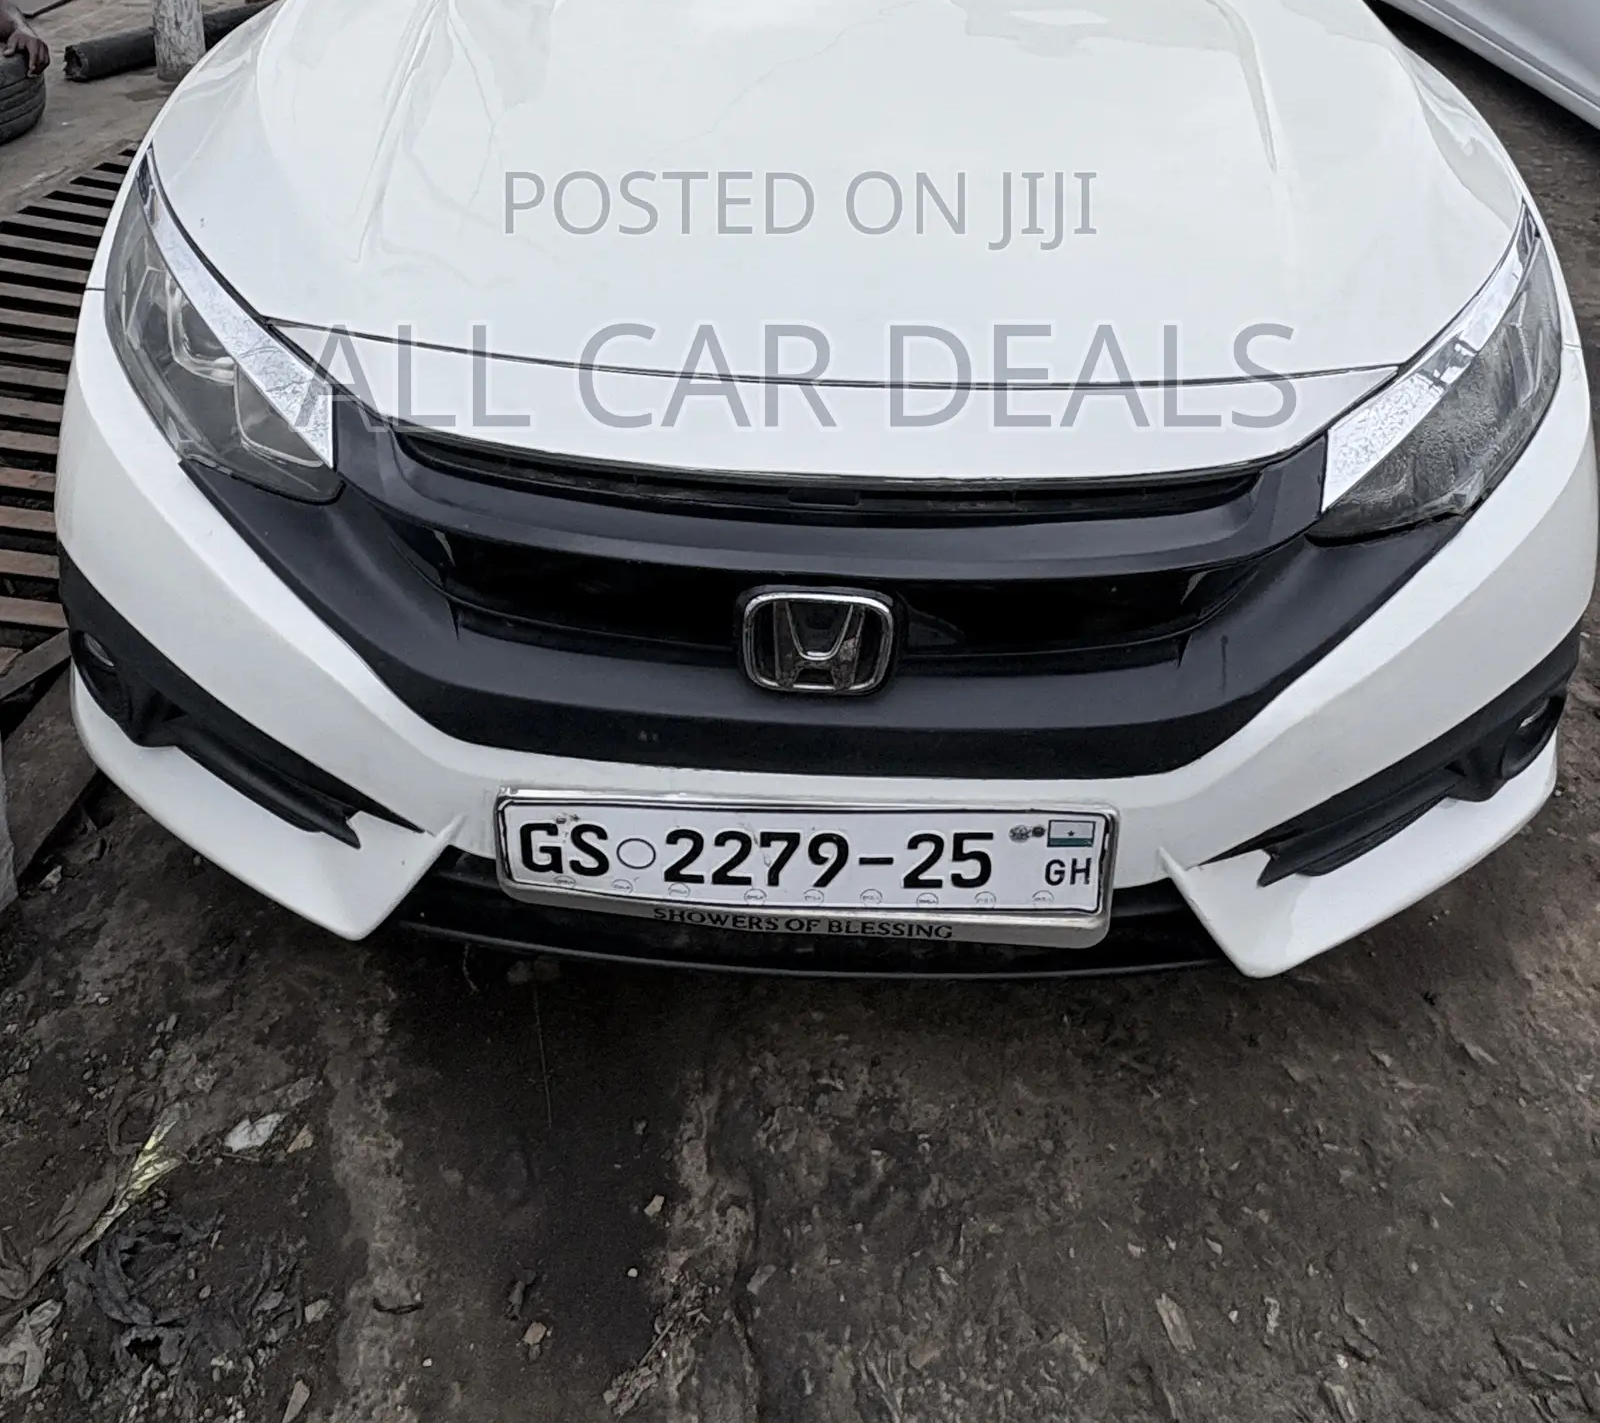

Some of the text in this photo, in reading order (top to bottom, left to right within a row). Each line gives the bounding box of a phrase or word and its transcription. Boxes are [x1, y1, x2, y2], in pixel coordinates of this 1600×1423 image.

[518, 822, 995, 889] GS 2279-25
[1044, 857, 1093, 886] GH
[653, 907, 953, 939] SHOWERS OF BLESSING
